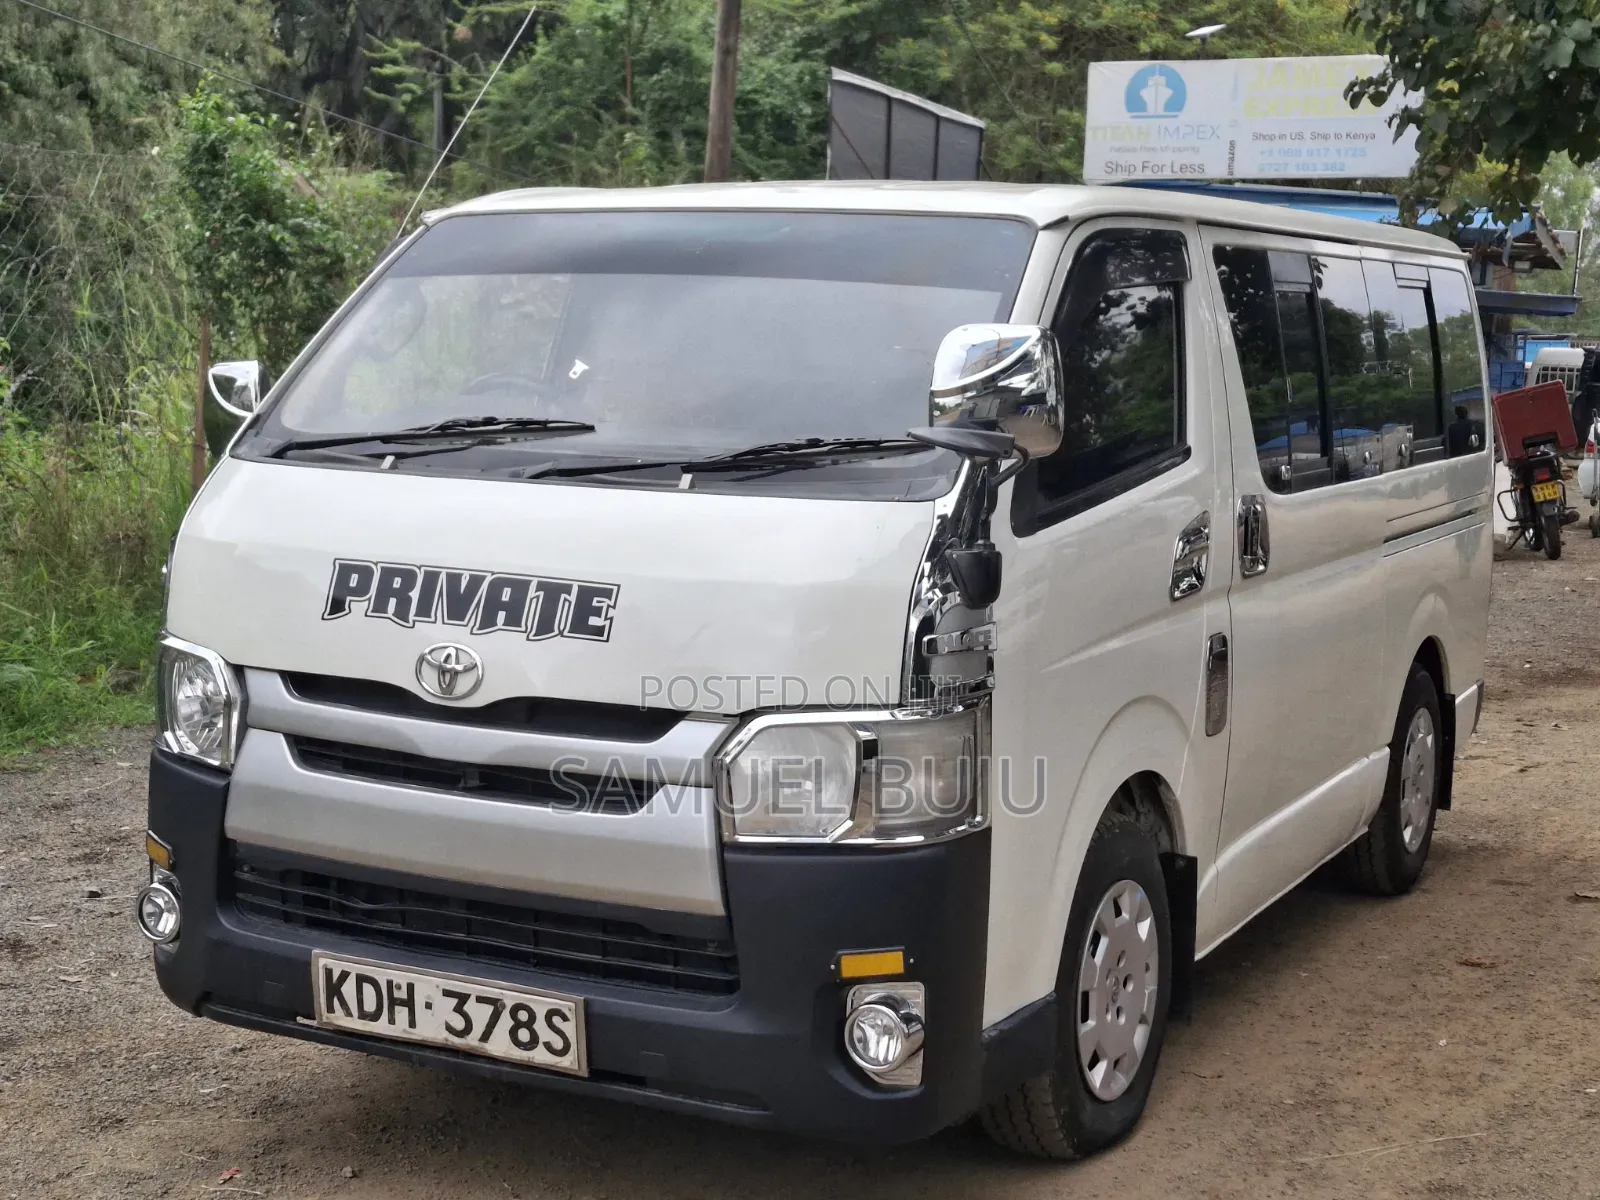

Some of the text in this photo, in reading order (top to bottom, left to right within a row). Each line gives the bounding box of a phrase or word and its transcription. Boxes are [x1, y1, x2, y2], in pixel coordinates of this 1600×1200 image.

[1157, 124, 1221, 140] IMPEX
[1252, 132, 1276, 142] Shop
[1279, 131, 1287, 140] in
[1310, 131, 1331, 142] Ship
[1334, 132, 1343, 140] to
[1346, 131, 1376, 142] Kenya
[1104, 160, 1205, 176] Ship For Less
[1227, 139, 1236, 176] amazon
[322, 558, 621, 642] PRIVATE
[324, 966, 572, 1058] KDH 378S
